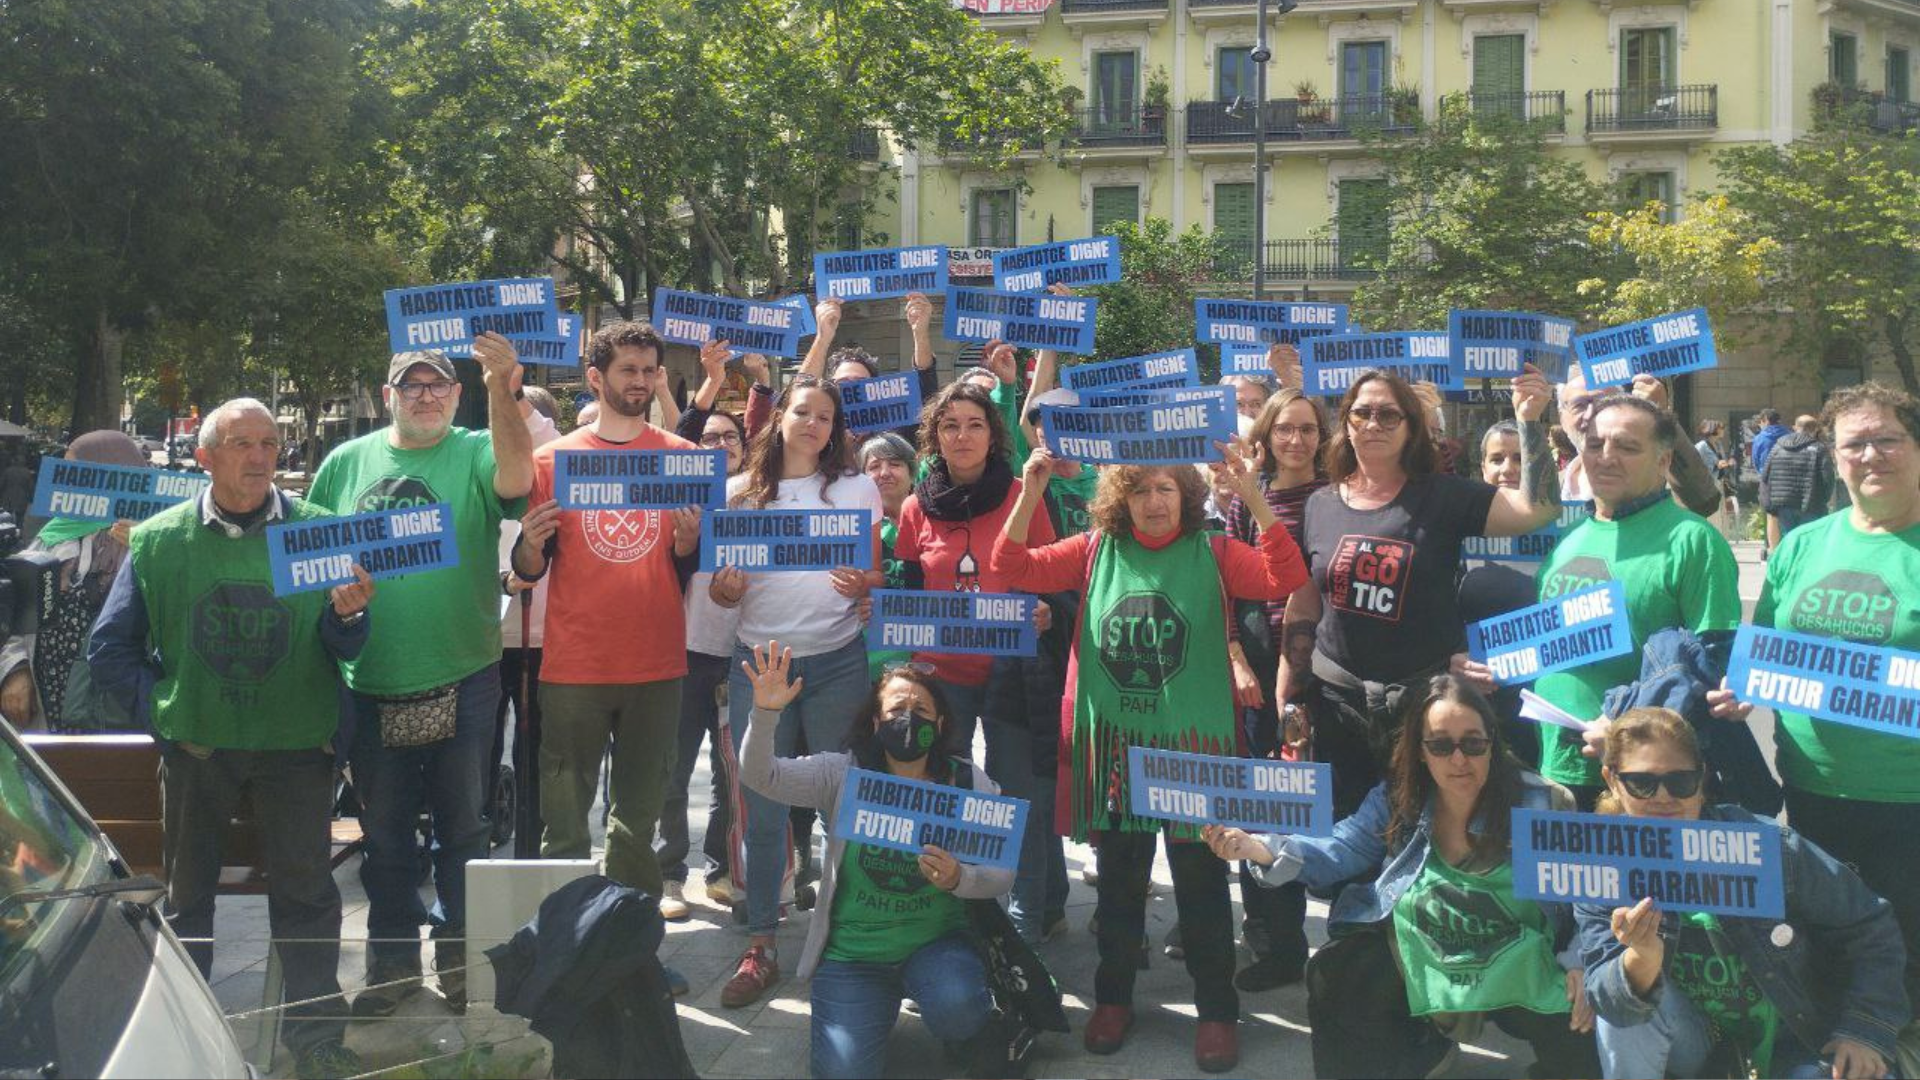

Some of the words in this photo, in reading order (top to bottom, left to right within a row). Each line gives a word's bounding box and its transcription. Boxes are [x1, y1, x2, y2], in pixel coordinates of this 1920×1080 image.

[824, 252, 896, 275] HABITATGE
[900, 249, 938, 269] DIGNE
[1001, 247, 1066, 272] HABITATGE
[1070, 240, 1109, 260] DIGNE
[828, 277, 871, 297] FUTUR
[875, 272, 937, 293] GARANTIT
[1005, 272, 1042, 292] FUTUR
[1046, 263, 1108, 285] GARANTIT
[400, 286, 497, 316] HABITATGE
[499, 283, 545, 306] DIGNE
[666, 294, 744, 322] HABITATGE
[747, 306, 793, 328] DIGNE
[956, 291, 1035, 317] HABITATGE
[1040, 299, 1086, 322] DIGNE
[1206, 303, 1286, 323] HABITATGE
[1291, 306, 1336, 325] DIGNE
[407, 318, 465, 345] FUTUR
[470, 311, 545, 335] GARANTIT
[664, 318, 711, 342] FUTUR
[715, 326, 786, 351] GARANTIT
[957, 316, 1002, 339] FUTUR
[1006, 322, 1080, 346] GARANTIT
[1210, 324, 1256, 342] FUTUR
[1460, 316, 1542, 340] HABITATGE
[1583, 326, 1652, 359] HABITATGE
[1653, 314, 1700, 344] DIGNE
[1234, 355, 1273, 371] FUTU
[1313, 338, 1404, 362] HABITATGE
[1409, 336, 1449, 357] DIGN
[1464, 347, 1518, 371] FUTUR
[1591, 357, 1630, 384] FUTUR
[1631, 342, 1700, 375] GARANTIT
[1071, 362, 1141, 390] HABITATGE
[1145, 354, 1188, 378] DIGNE
[865, 377, 909, 401] DIGNE
[1052, 410, 1148, 433] HABITATGE
[1153, 404, 1209, 432] DIGNE
[1059, 437, 1113, 459] FUTUR
[1119, 436, 1207, 460] GARANTIT
[53, 464, 151, 493] HABITATGE
[567, 455, 659, 476] HABITATGE
[664, 455, 714, 476] DIGNE
[50, 491, 110, 517] FUTUR
[569, 483, 623, 504] FUTUR
[629, 483, 711, 504] GARANTIT
[283, 517, 387, 555] HABITATGE
[391, 509, 442, 538] DIGNE
[713, 515, 804, 538] HABITATGE
[810, 514, 860, 537] DIGNE
[716, 545, 768, 567] FUTUR
[774, 543, 856, 566] GARANTIT
[1359, 541, 1372, 552] AL
[1462, 536, 1512, 555] UTUR
[291, 554, 354, 587] FUTUR
[360, 540, 442, 573] GARANTIT
[1332, 541, 1358, 604] RESISTIM
[1356, 552, 1399, 585] GO
[882, 595, 970, 619] HABITATGE
[976, 598, 1025, 622] DIGNE
[1353, 581, 1394, 613] TIC
[1800, 587, 1892, 620] STOP
[203, 605, 279, 639] STOP
[1108, 615, 1176, 650] STOP
[1479, 605, 1560, 651] HABITATGE
[1562, 588, 1613, 628] DIGNE
[1796, 613, 1885, 638] DESAHUCIOS
[883, 623, 935, 647] FUTUR
[941, 626, 1021, 650] GARANTIT
[1487, 647, 1538, 679] FUTUR
[1540, 623, 1613, 667] GARANTIT
[1749, 632, 1882, 682] HABITATGE
[1746, 668, 1823, 710] FUTUR
[1120, 696, 1157, 714] PAH
[1144, 756, 1247, 790] HABITATGE
[1254, 765, 1316, 795] DIGNE
[857, 776, 959, 819] HABITATGE
[962, 796, 1016, 829] DIGNE
[1148, 786, 1207, 818] FUTUR
[1213, 796, 1313, 828] GARANTIT
[854, 809, 914, 845] FUTUR
[919, 823, 1007, 860] GARANTIT
[1531, 820, 1673, 859] HABITATGE
[1681, 828, 1762, 865] DIGNE
[1537, 861, 1619, 899] FUTUR
[1628, 868, 1758, 908] GARANTIT
[856, 890, 889, 912] PAH
